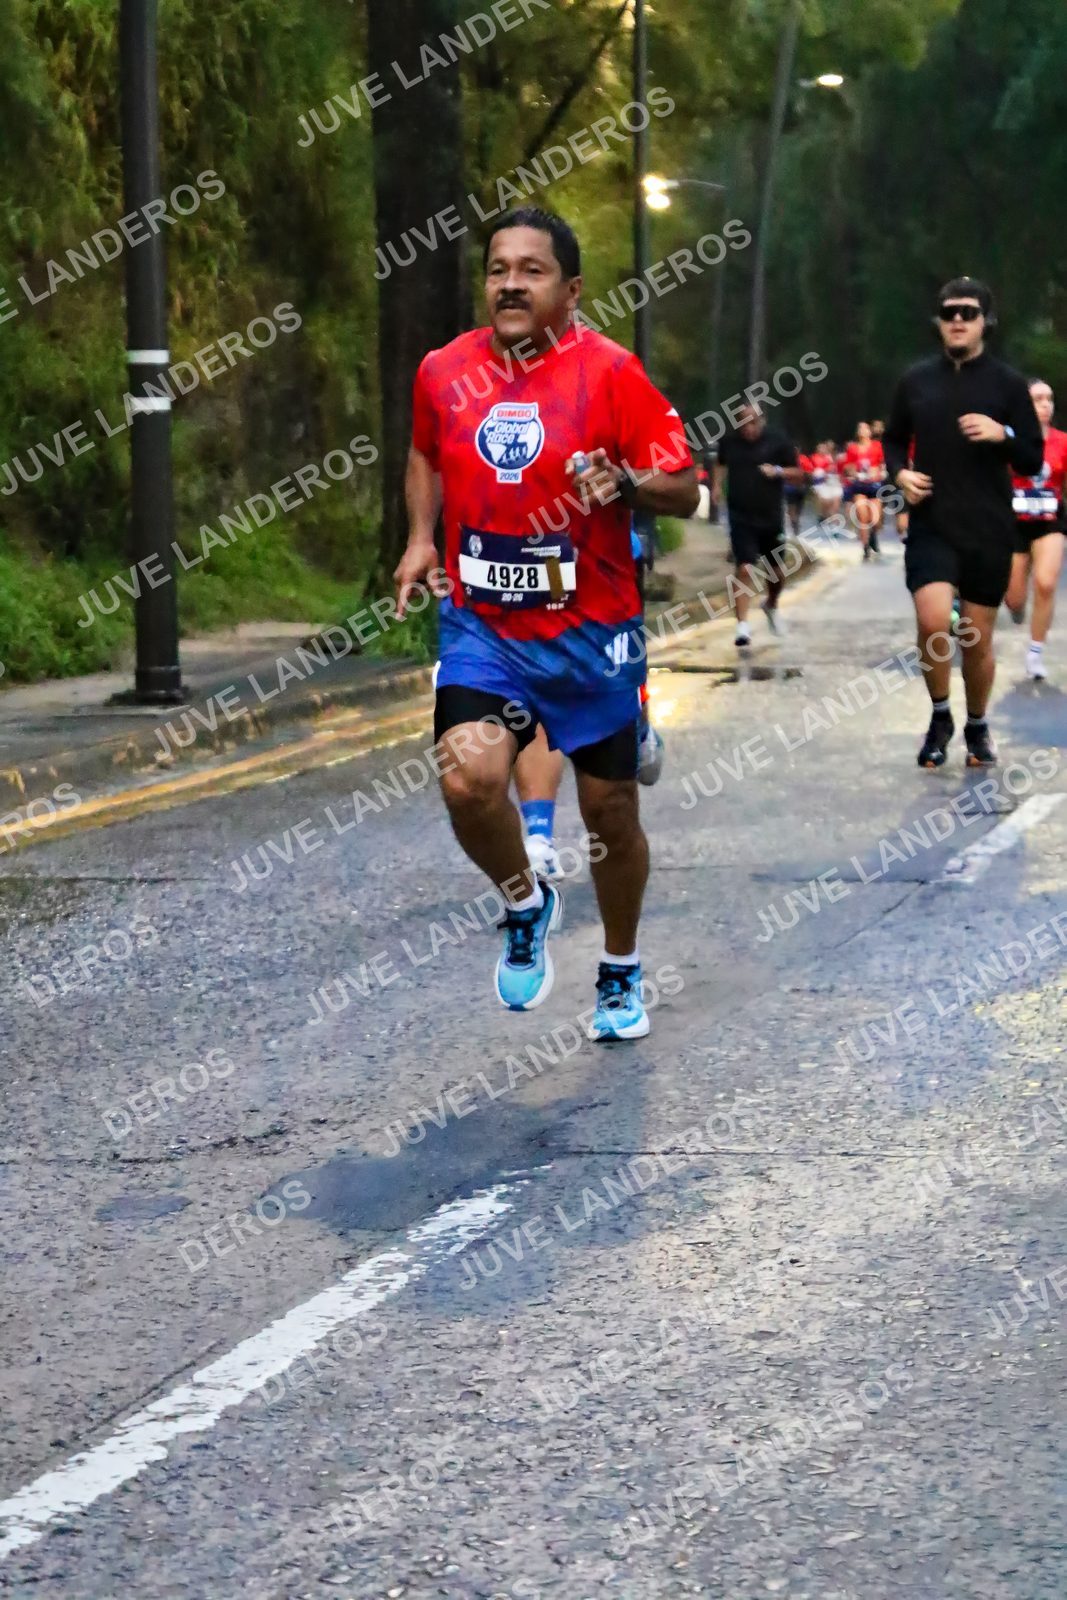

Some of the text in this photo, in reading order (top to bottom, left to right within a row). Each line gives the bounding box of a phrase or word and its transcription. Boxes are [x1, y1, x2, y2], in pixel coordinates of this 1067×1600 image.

[495, 421, 530, 433] Global
[486, 432, 515, 444] Race
[500, 472, 520, 481] 2026
[487, 564, 539, 589] 4928
